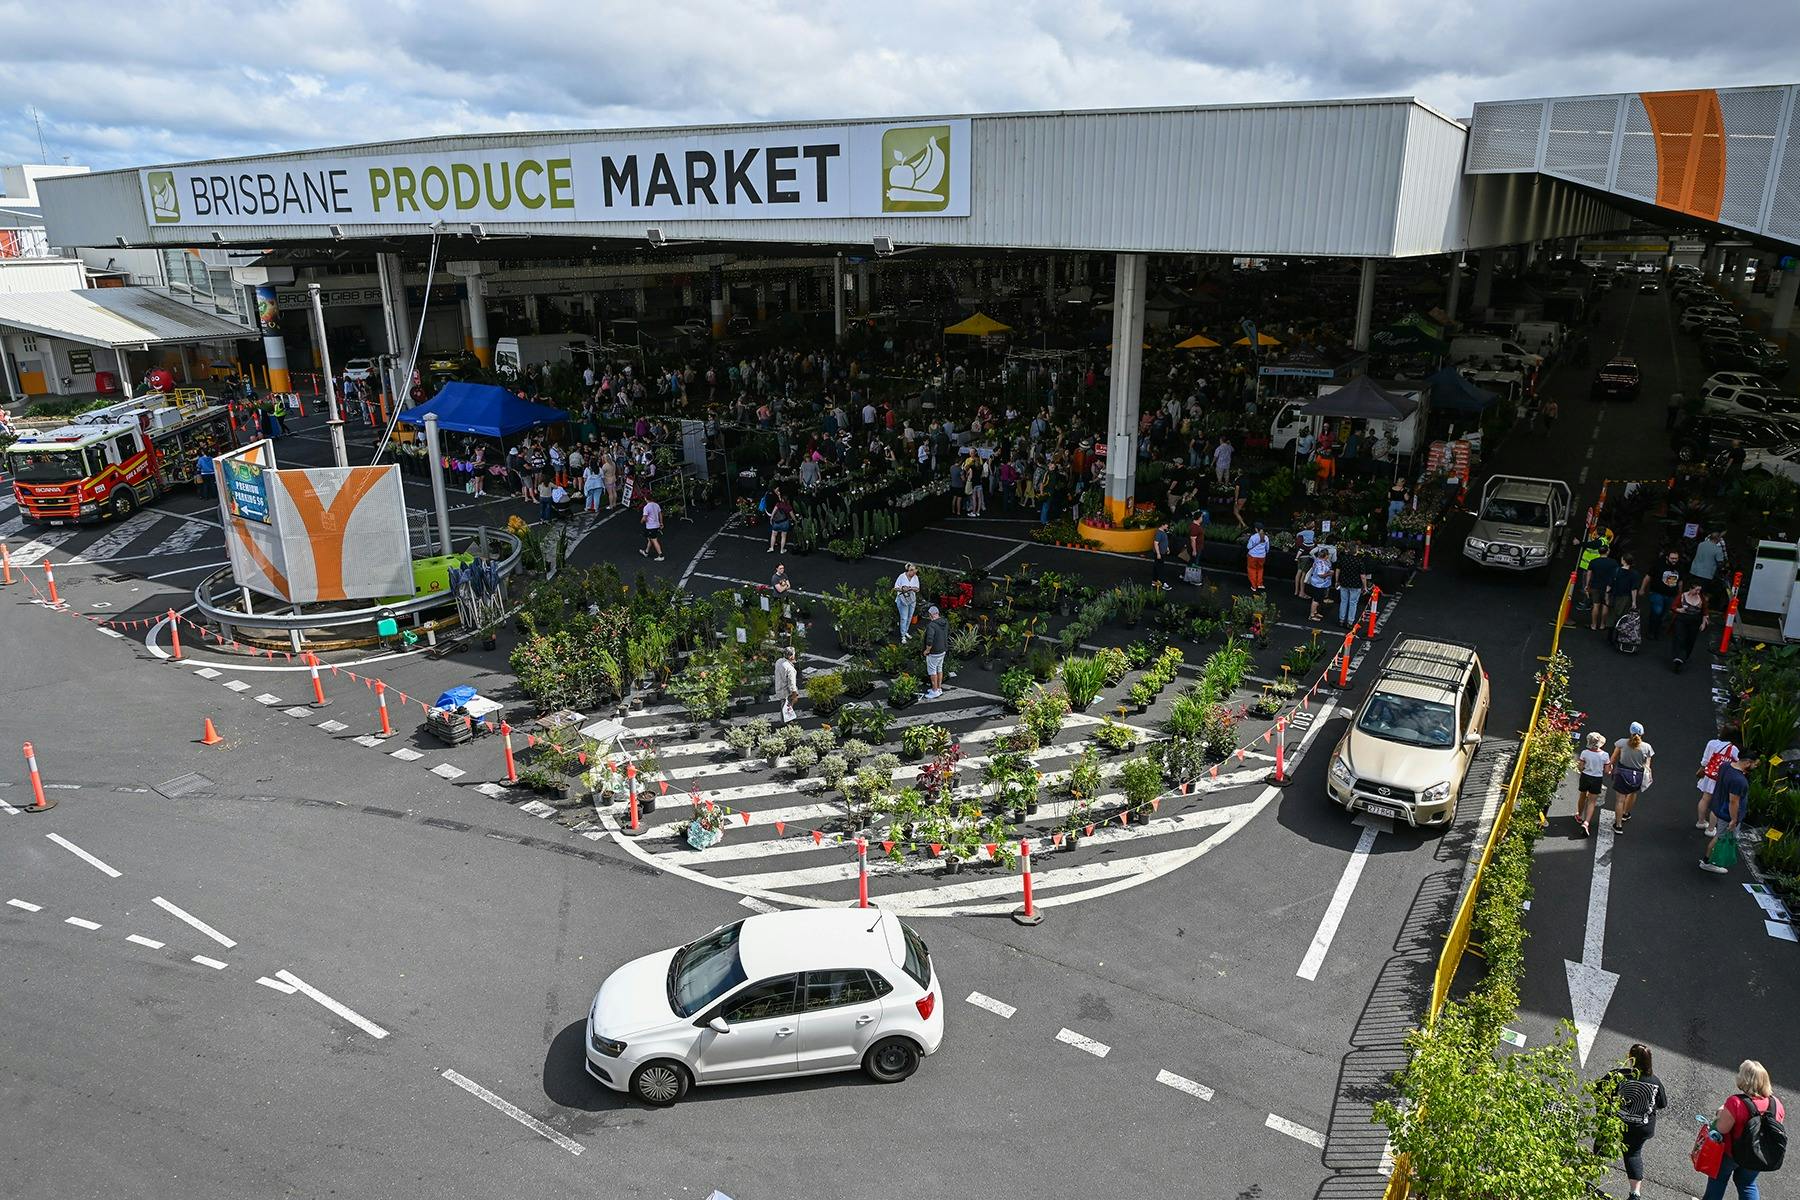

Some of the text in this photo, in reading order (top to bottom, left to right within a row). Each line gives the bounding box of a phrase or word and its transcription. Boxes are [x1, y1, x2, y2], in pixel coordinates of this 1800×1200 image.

[191, 144, 841, 216] BRISBANE PRODUCE MARKET
[331, 291, 360, 301] GIBB
[235, 480, 259, 494] PREMIUM
[234, 491, 257, 504] PARKING
